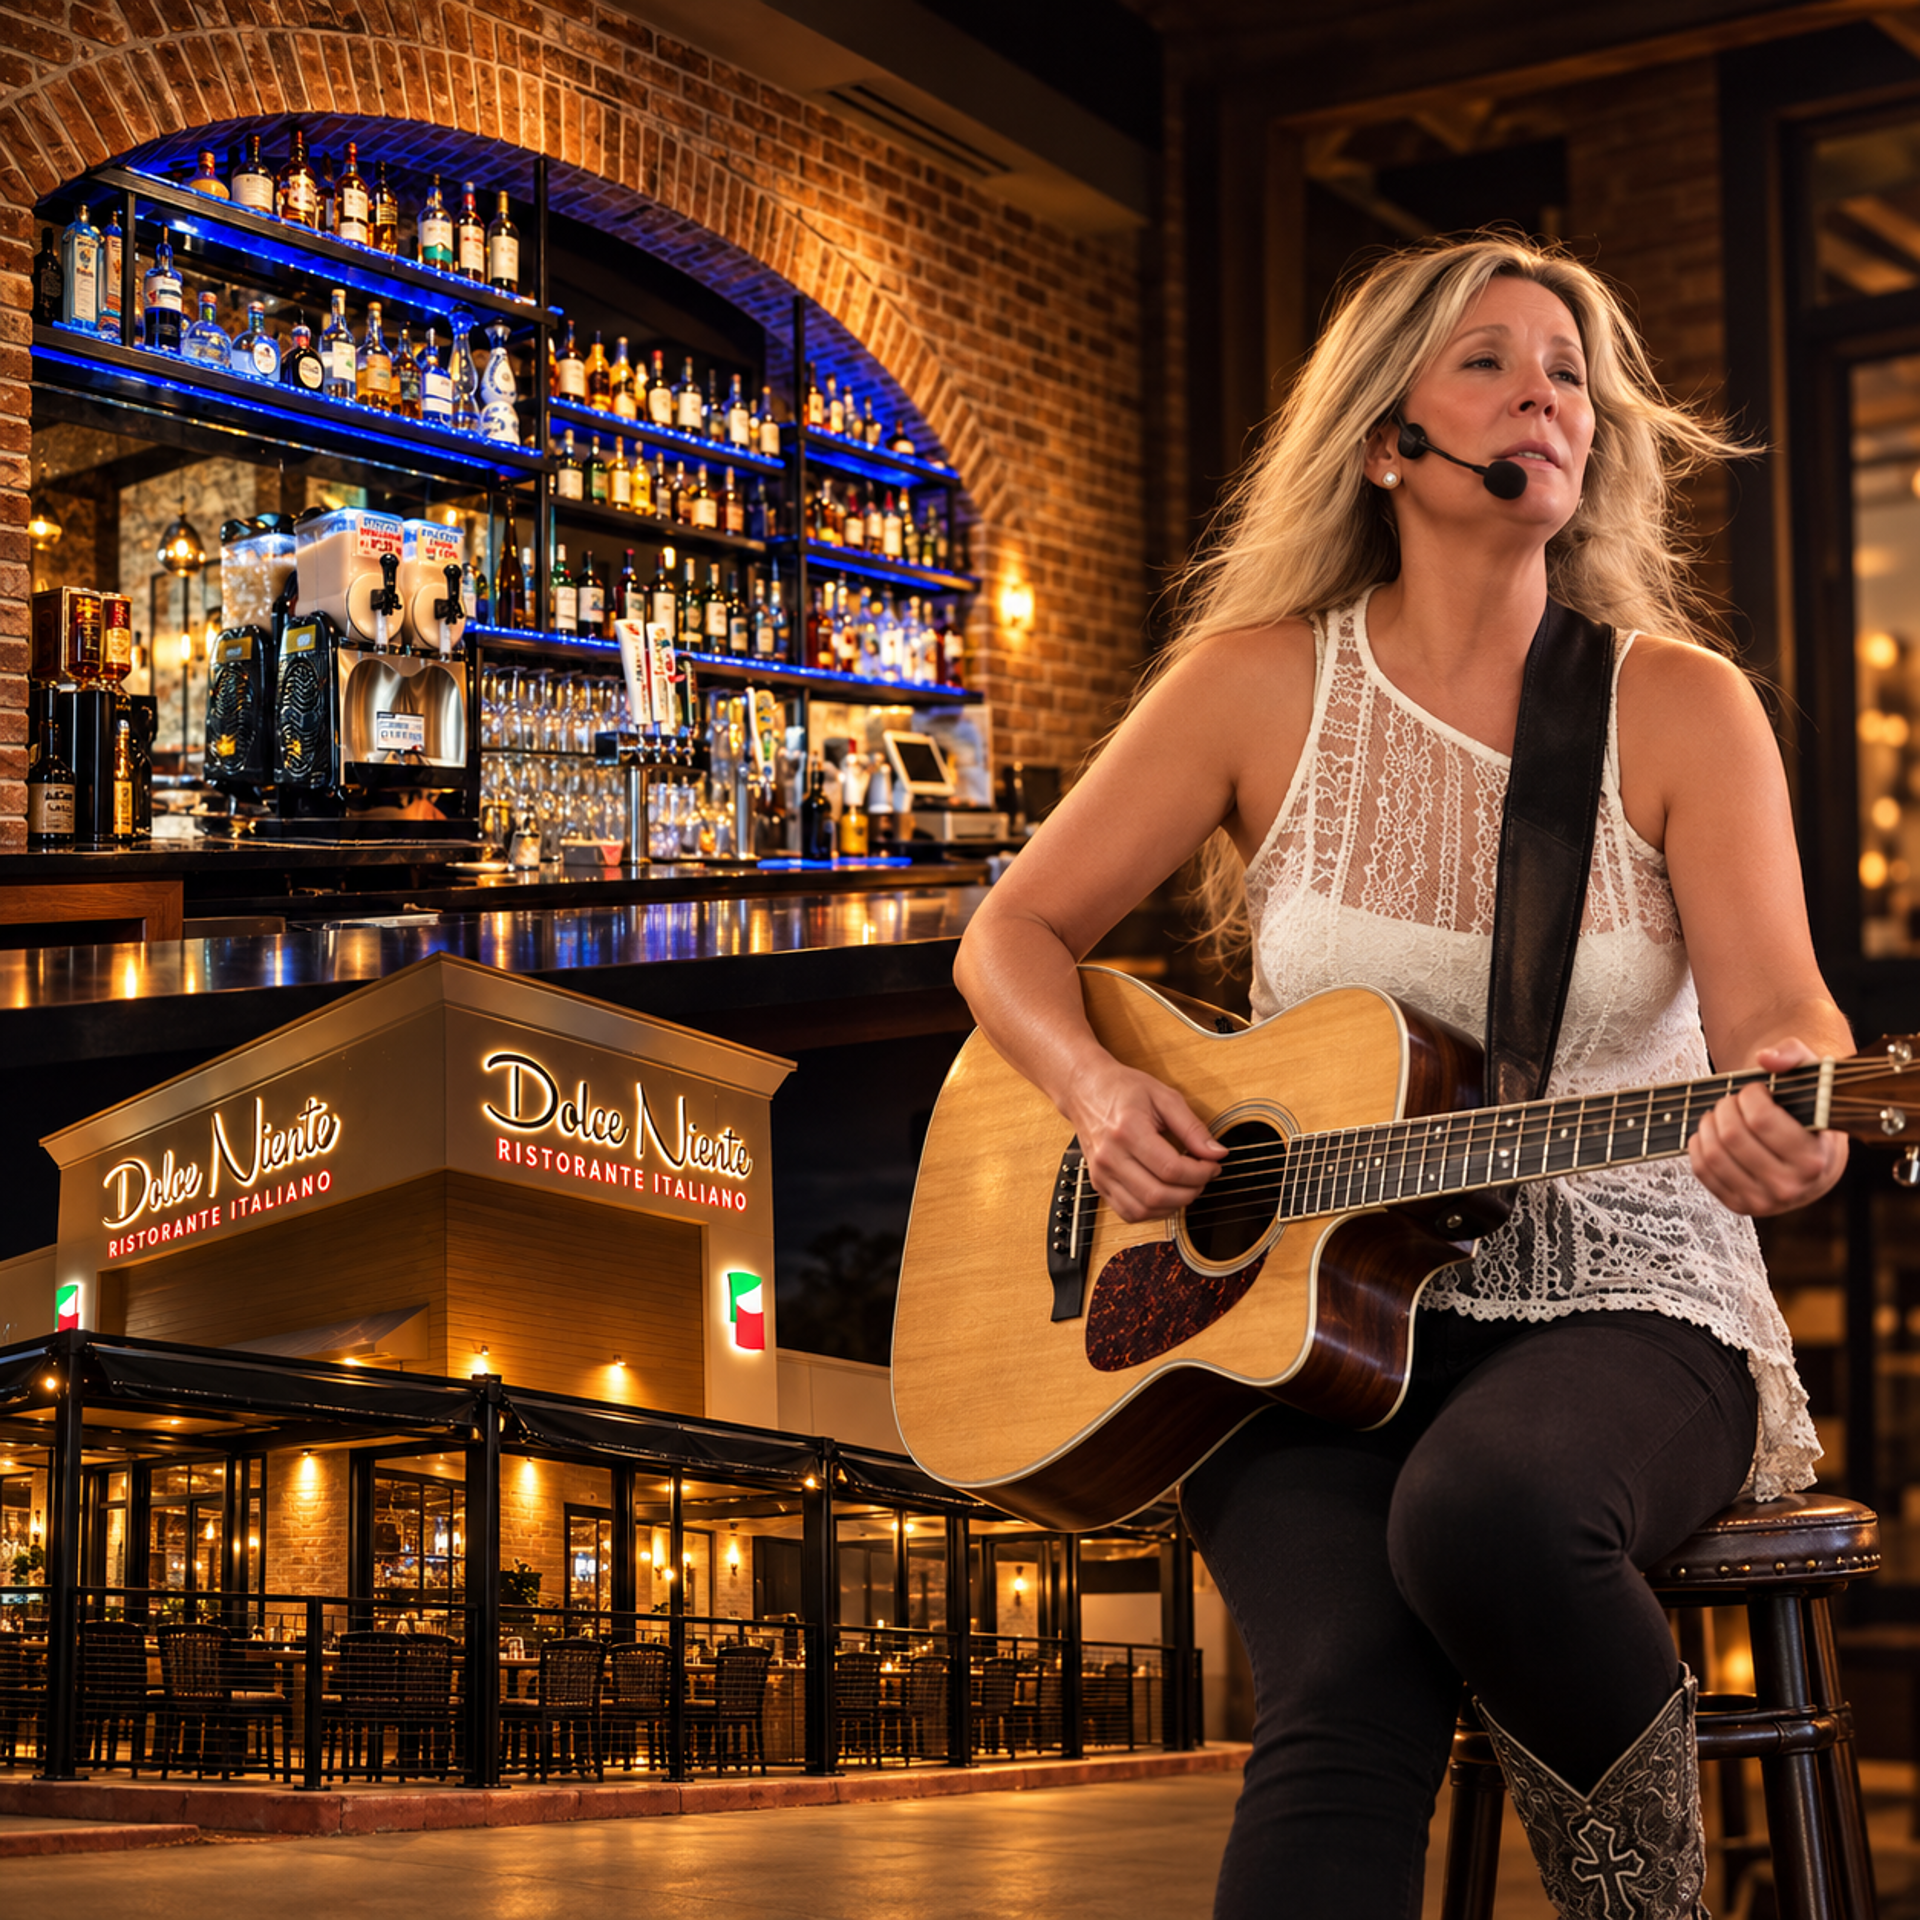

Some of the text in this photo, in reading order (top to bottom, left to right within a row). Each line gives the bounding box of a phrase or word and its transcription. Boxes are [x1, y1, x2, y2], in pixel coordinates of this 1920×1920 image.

[102, 1096, 341, 1229] Dolce Niente
[484, 1052, 752, 1179] Dolce Niente
[109, 1170, 331, 1259] RISTORANTE ITALIANO
[497, 1137, 747, 1211] RISTORANTE ITALIANO
